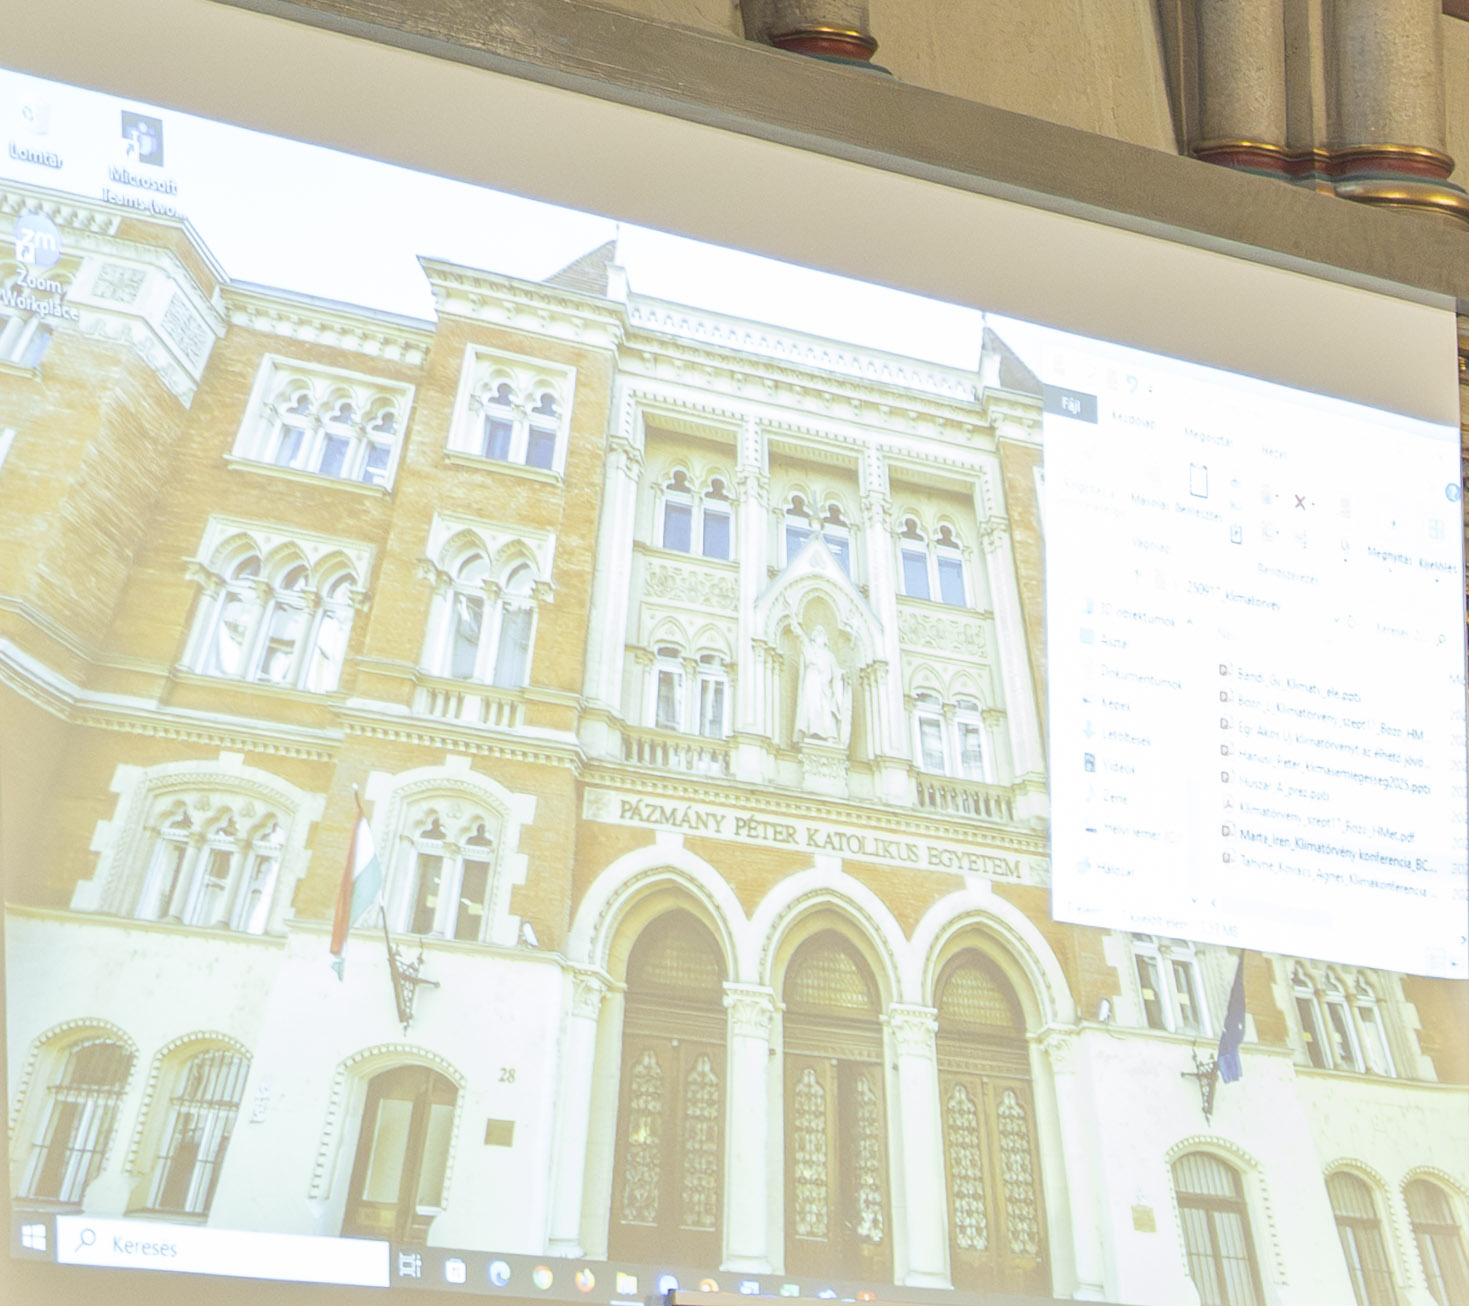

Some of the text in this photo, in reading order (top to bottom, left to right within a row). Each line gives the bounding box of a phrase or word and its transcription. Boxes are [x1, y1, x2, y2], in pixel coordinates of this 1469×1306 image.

[109, 167, 178, 194] Microsoft
[16, 269, 62, 293] Zoom
[619, 798, 1022, 879] PÁZMÁNY PÉTER KATOLIKUS EGYETEM
[113, 1236, 177, 1258] Keresés
